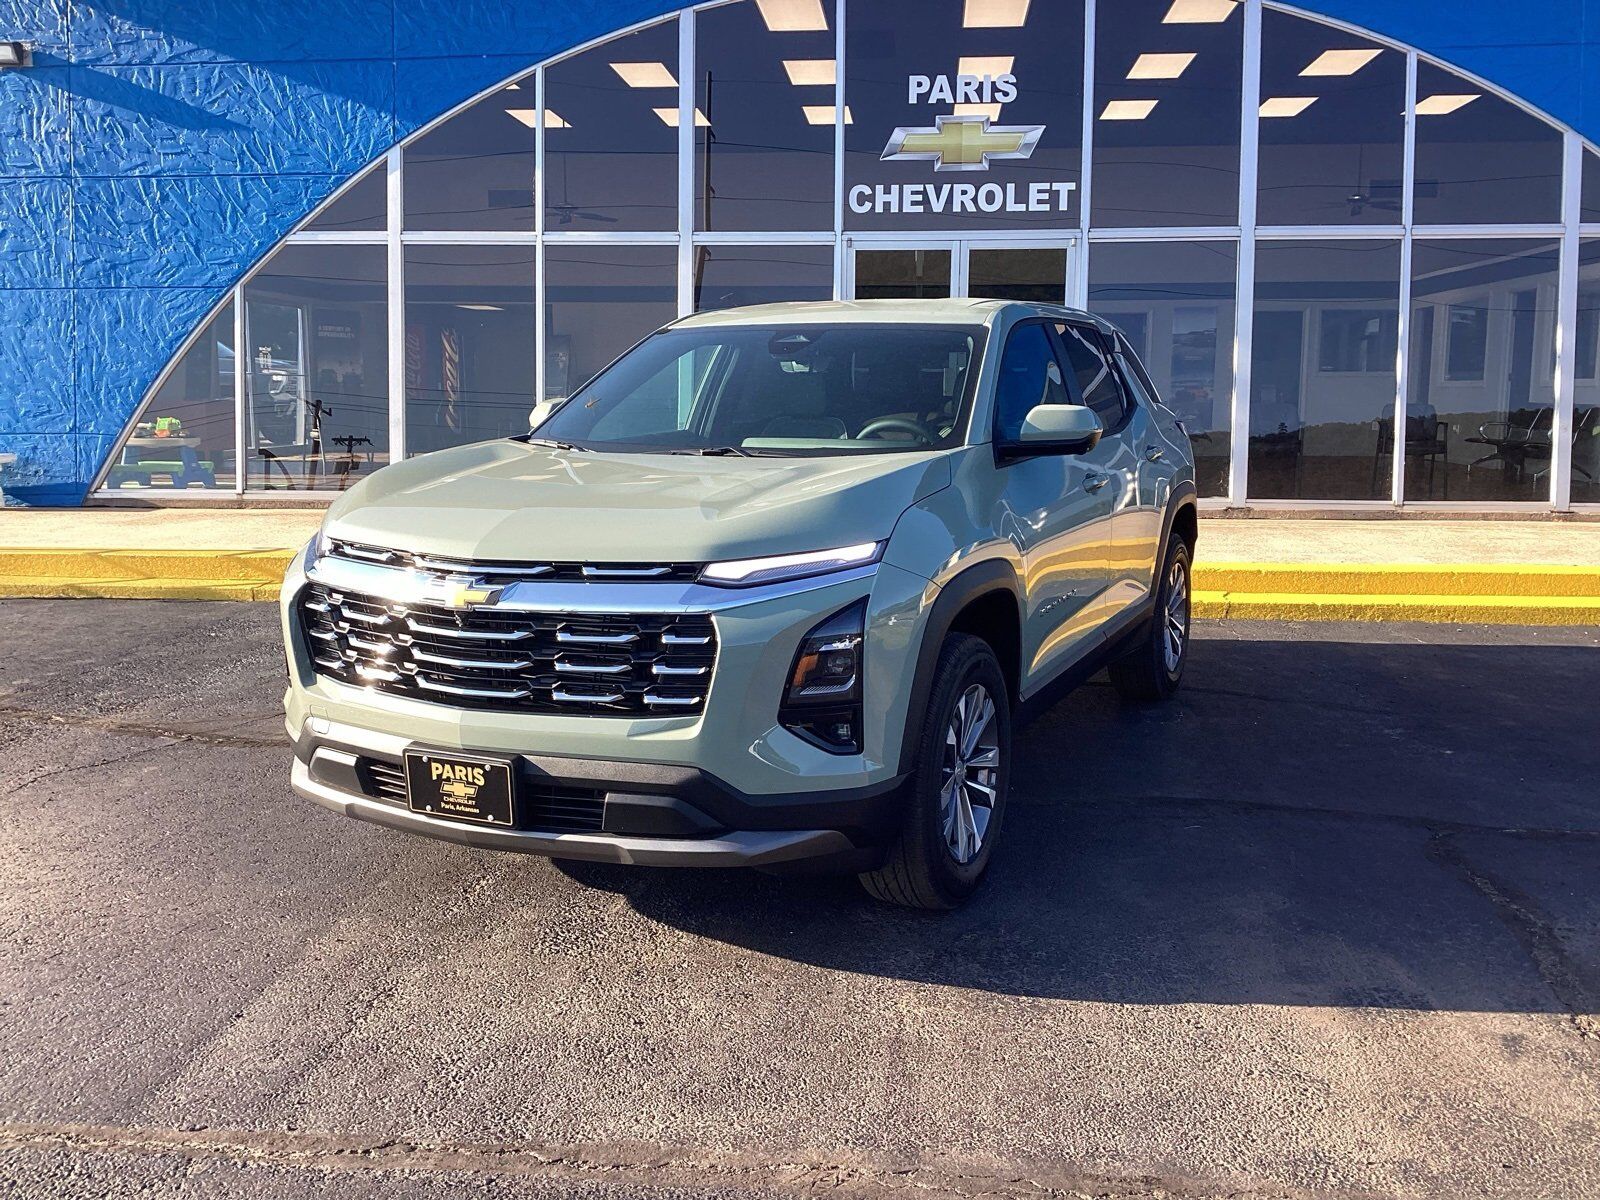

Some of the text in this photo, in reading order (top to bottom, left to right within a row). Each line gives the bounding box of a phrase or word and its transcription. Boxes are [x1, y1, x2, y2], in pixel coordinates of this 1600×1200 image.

[909, 74, 1017, 104] PARIS
[849, 182, 1076, 213] CHEVROLET
[431, 762, 485, 786] PARIS
[441, 801, 480, 814] Paris, Arkansas
[443, 796, 476, 806] CHEVROLET
